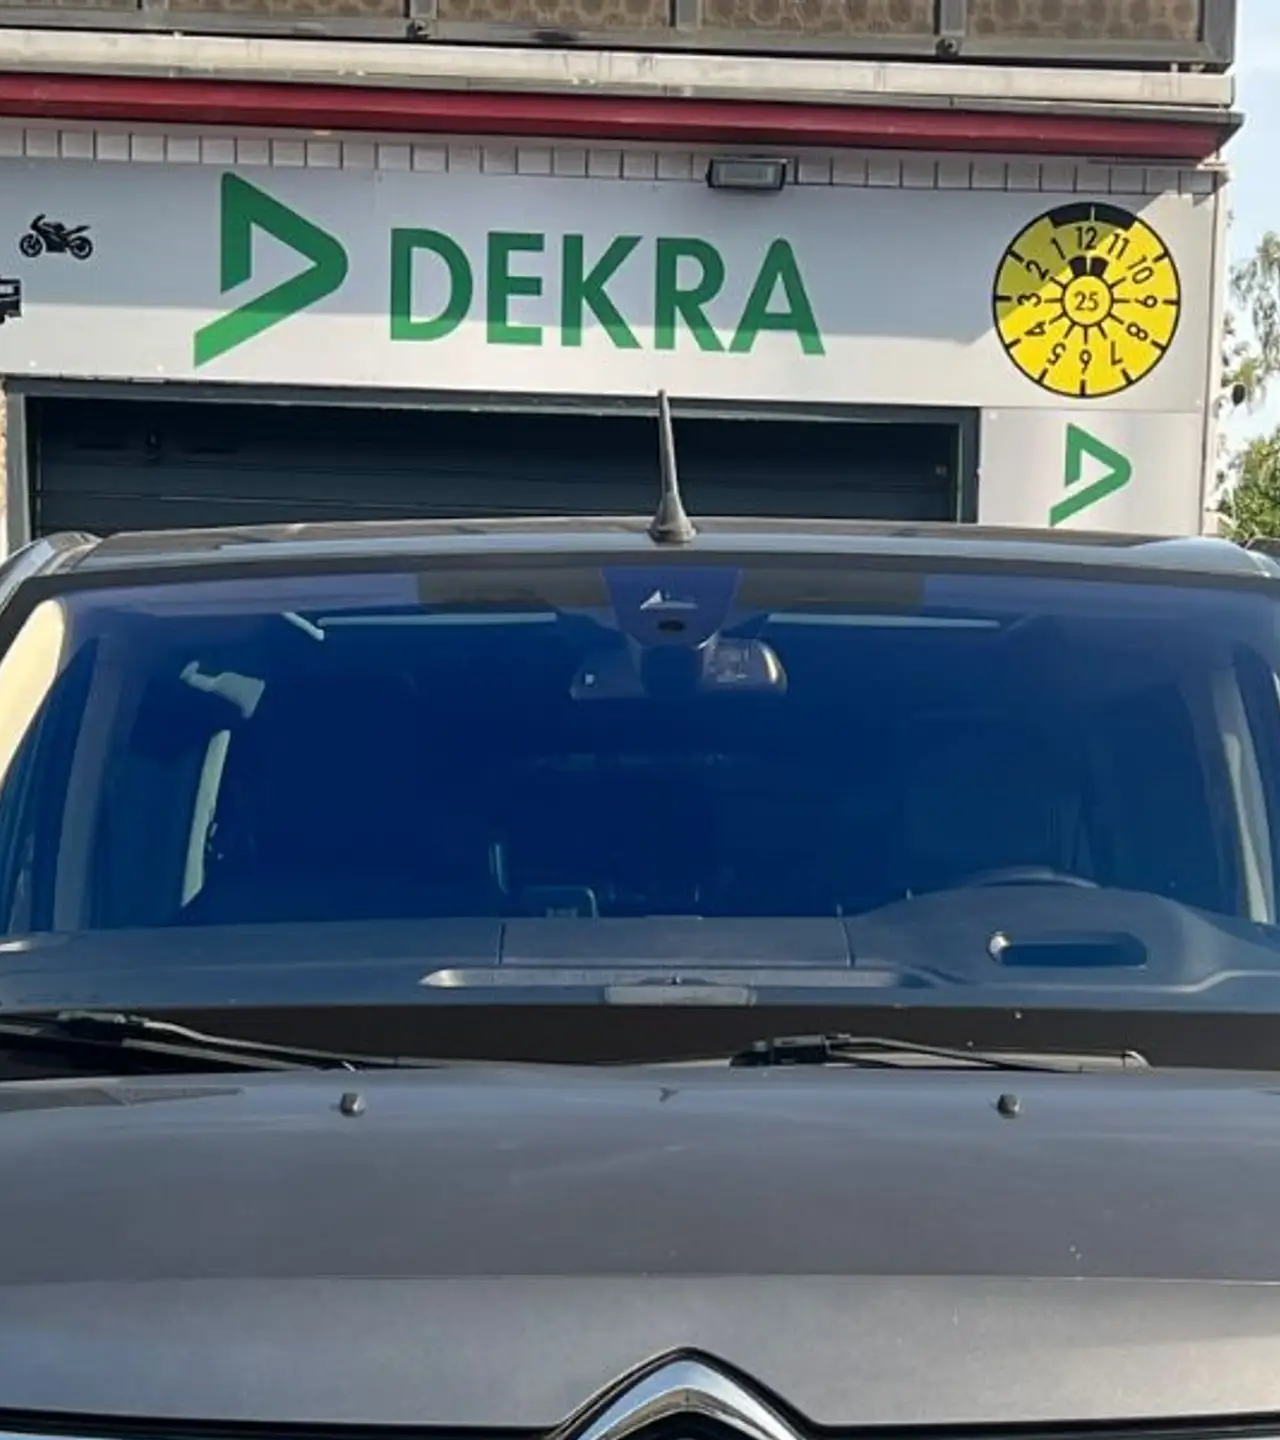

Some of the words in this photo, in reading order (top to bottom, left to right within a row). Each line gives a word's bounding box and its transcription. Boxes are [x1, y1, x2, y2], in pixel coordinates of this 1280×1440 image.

[1050, 238, 1066, 260] 1
[1076, 227, 1097, 250] 12
[1108, 233, 1131, 260] 11
[1026, 259, 1050, 281] 2
[1127, 255, 1154, 284] 10
[390, 227, 826, 357] DEKRA
[1017, 292, 1042, 308] 3
[1074, 291, 1100, 312] 25
[1135, 295, 1158, 309] 9
[1024, 321, 1047, 337] 4
[1126, 322, 1149, 342] 8
[1046, 342, 1066, 366] 5
[1079, 349, 1093, 373] 6
[1110, 340, 1123, 366] 7
